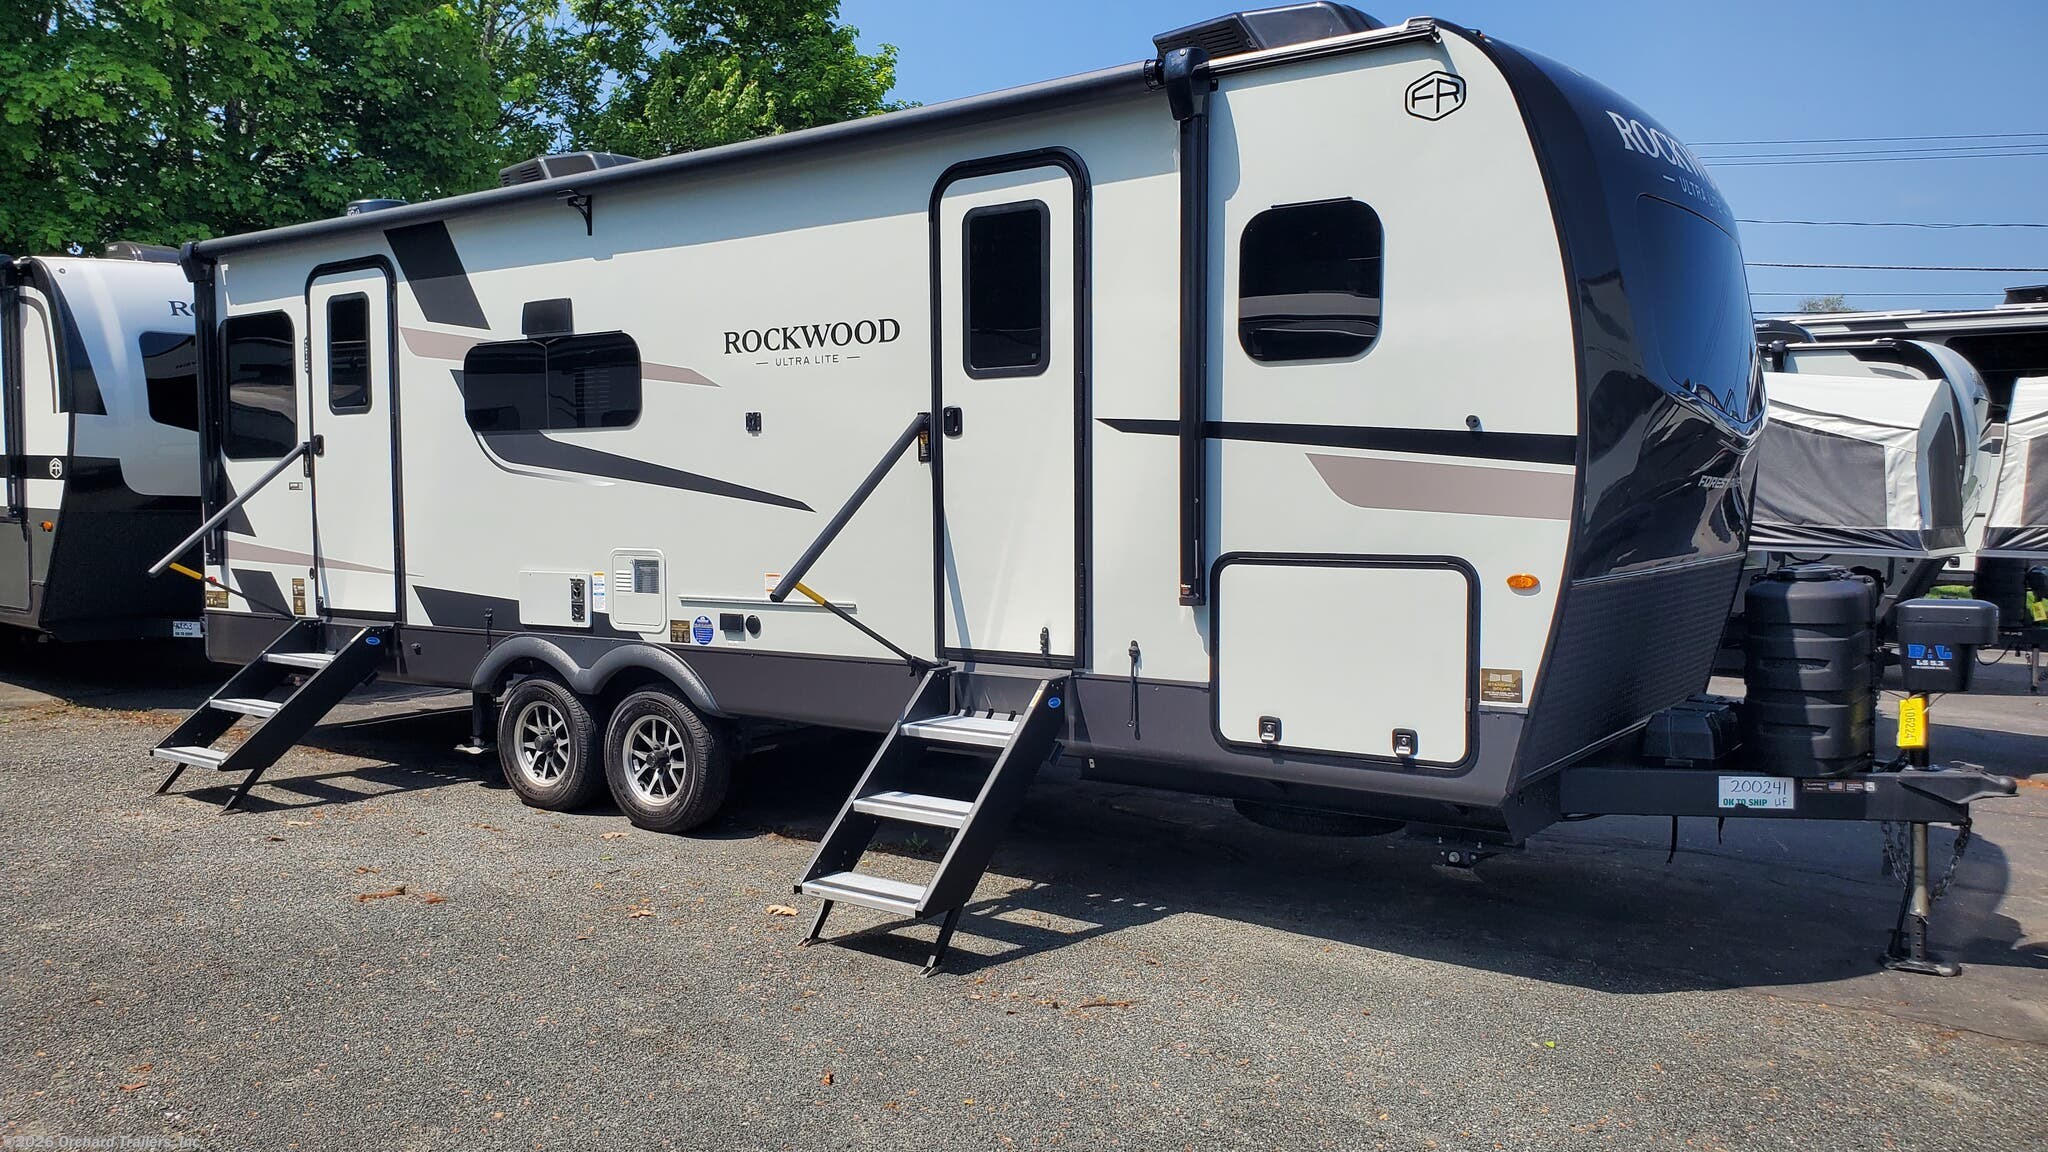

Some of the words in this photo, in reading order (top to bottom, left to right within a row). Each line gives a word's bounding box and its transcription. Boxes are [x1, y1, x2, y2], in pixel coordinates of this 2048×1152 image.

[167, 300, 196, 316] R
[723, 318, 901, 355] ROCKWOOD
[775, 356, 810, 367] ULTRA
[814, 354, 840, 364] LITE
[1697, 474, 1730, 489] FOREST
[1730, 779, 1787, 795] 200241
[1722, 798, 1735, 806] OK
[1748, 799, 1768, 807] SHIP
